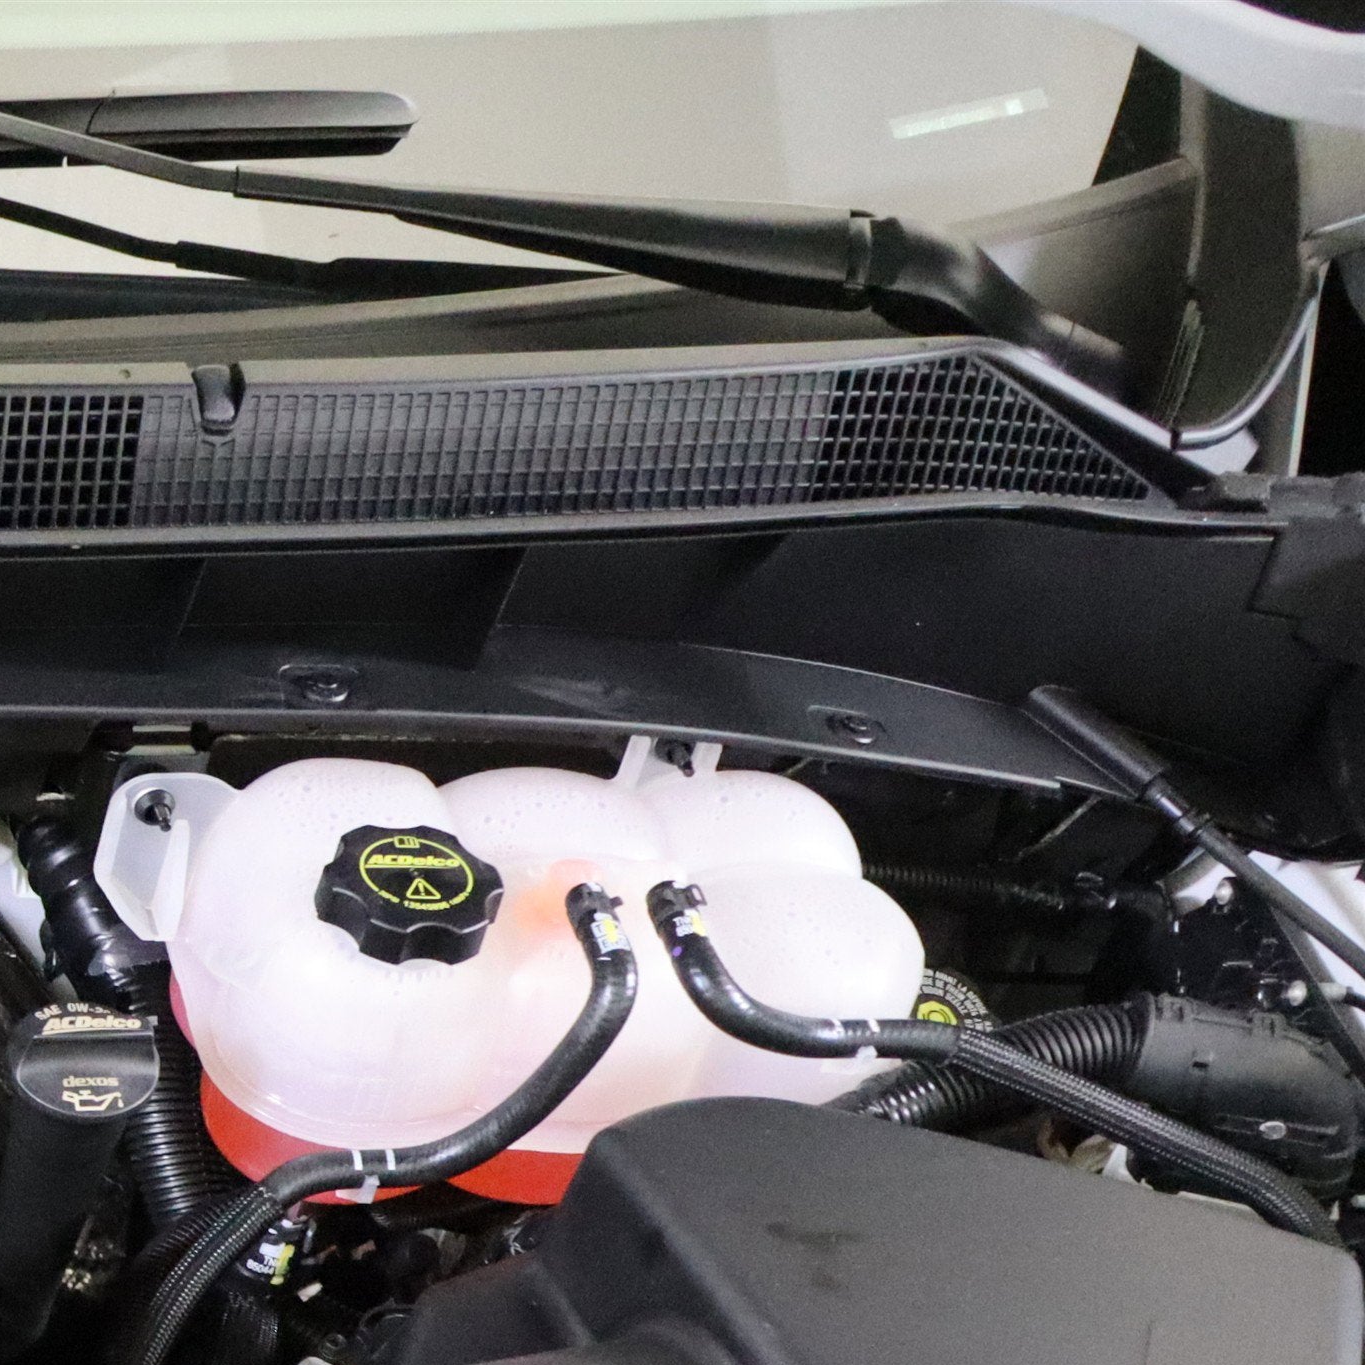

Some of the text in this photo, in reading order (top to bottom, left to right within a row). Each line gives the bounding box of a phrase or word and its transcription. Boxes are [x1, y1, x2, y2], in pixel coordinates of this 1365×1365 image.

[365, 854, 461, 868] ACDelco
[35, 1005, 62, 1020] SAE
[42, 1015, 141, 1034] ACDelco
[62, 1076, 119, 1087] dexos
